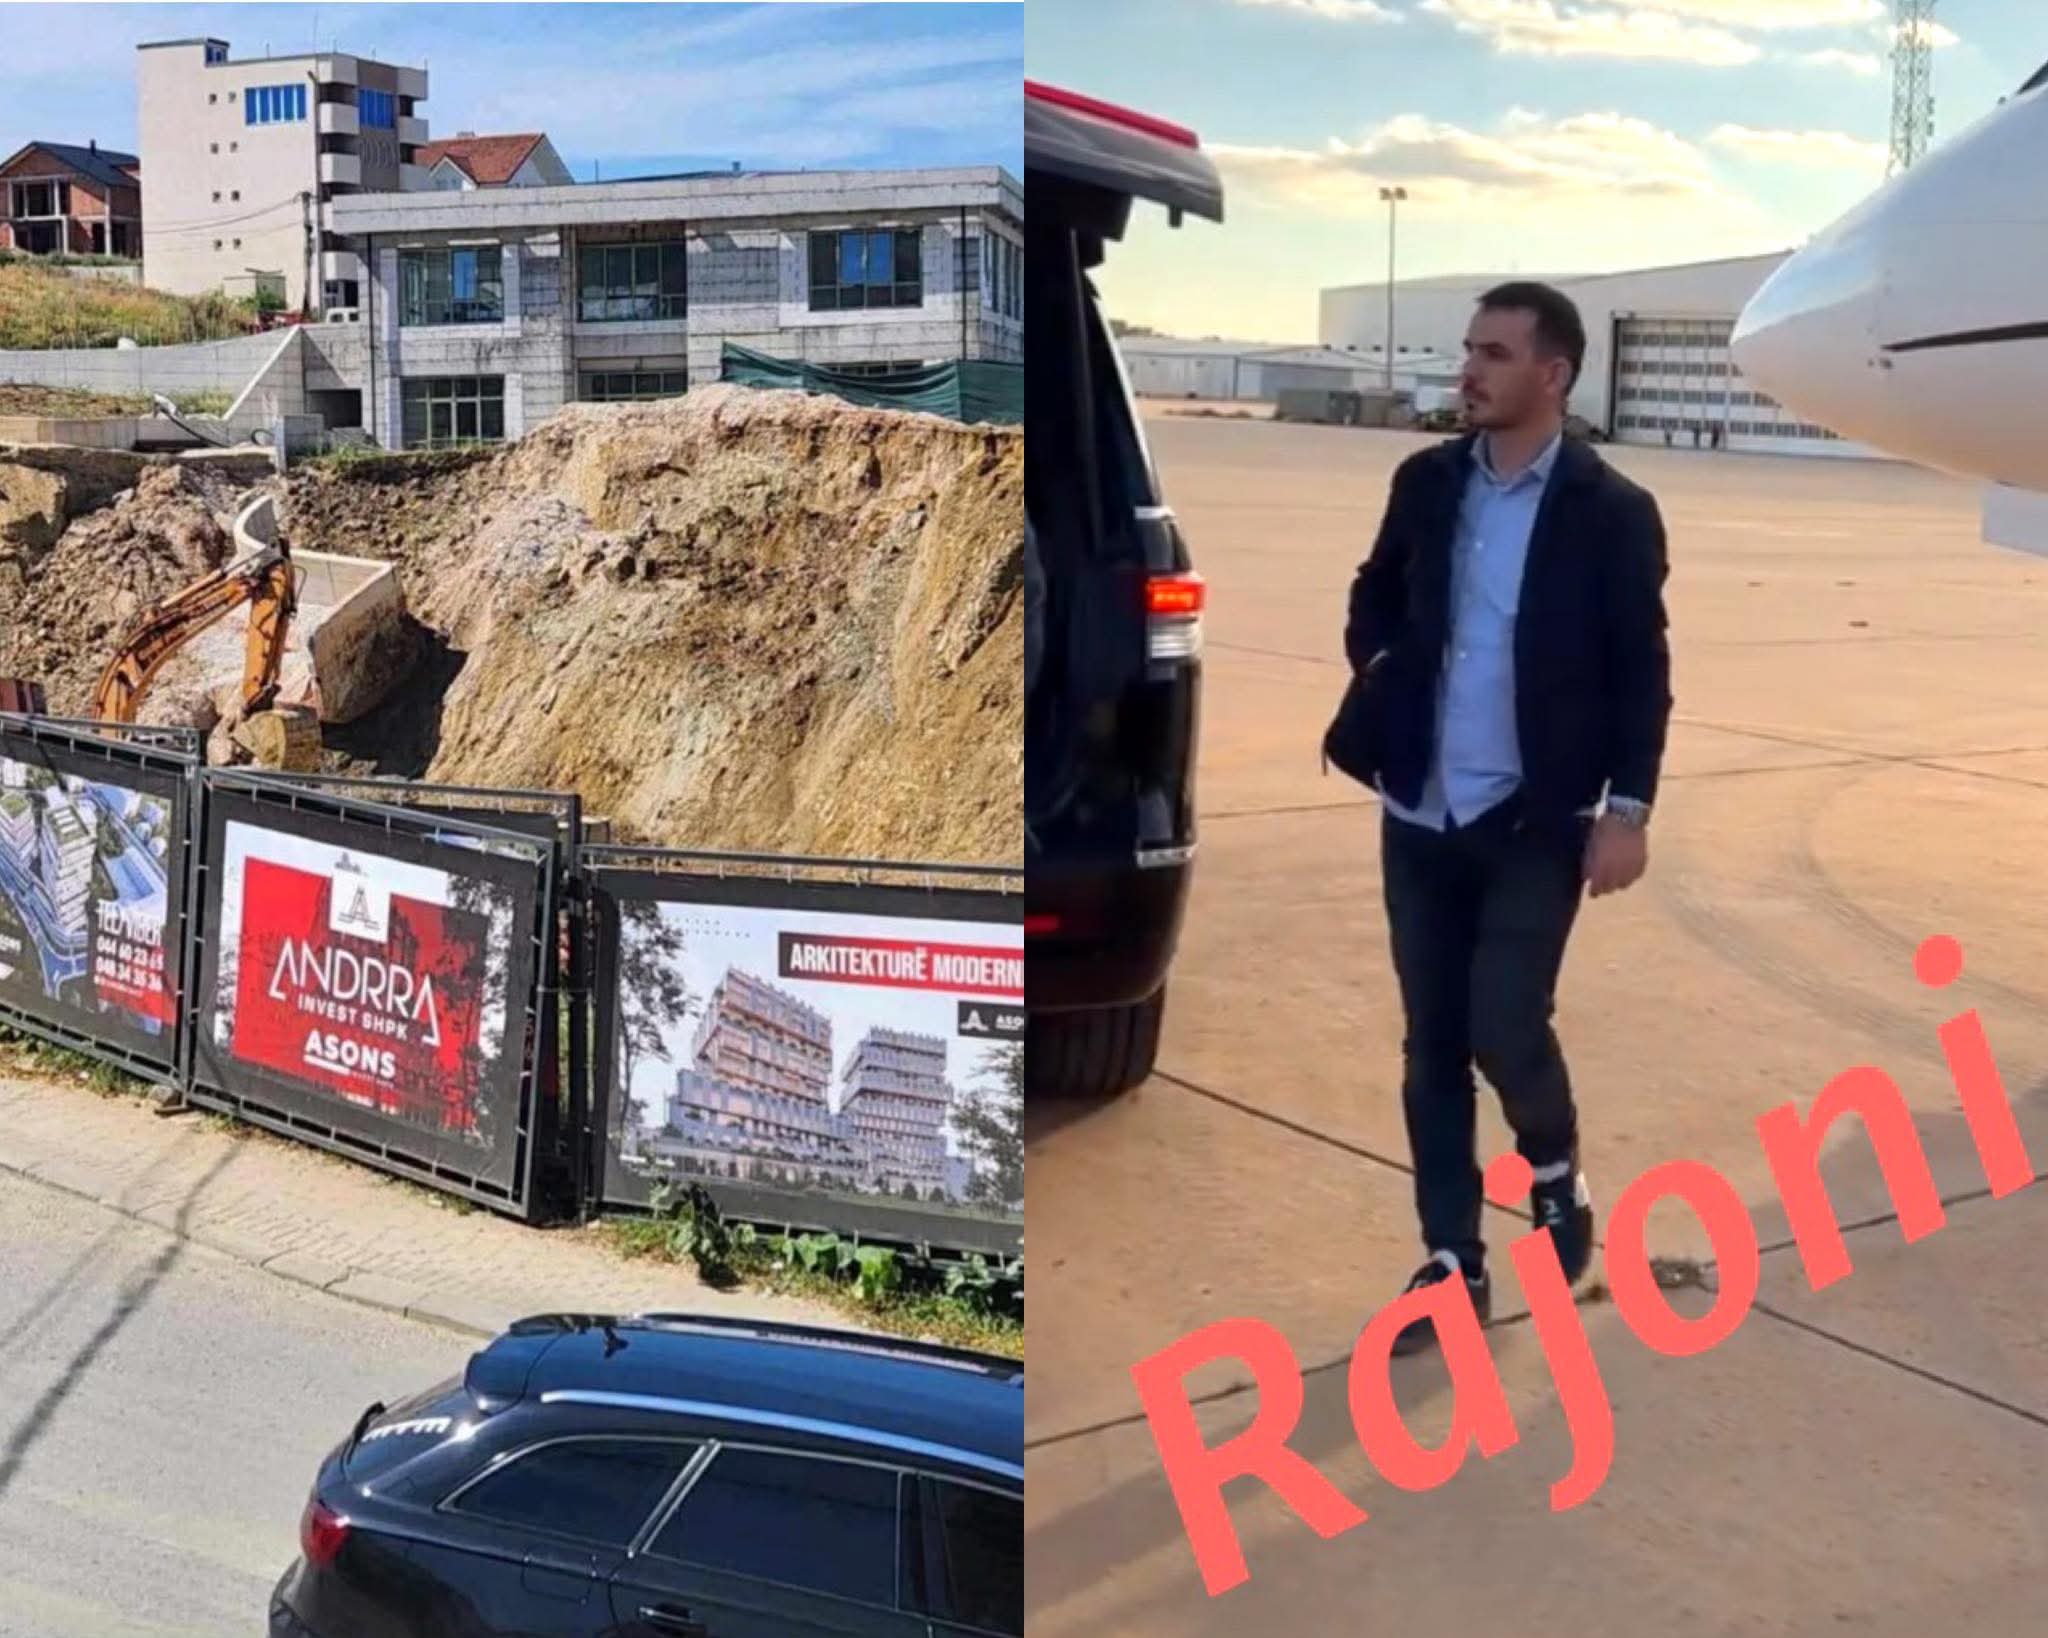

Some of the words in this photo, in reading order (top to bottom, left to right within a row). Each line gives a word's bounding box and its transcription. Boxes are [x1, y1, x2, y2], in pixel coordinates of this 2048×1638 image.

[790, 942, 928, 981] ARKITEKTURË
[932, 953, 1024, 988] MODERN
[269, 937, 441, 1047] ANDRRA
[298, 992, 358, 1026] INVEST
[361, 1011, 408, 1042] SHPK
[995, 1014, 1024, 1027] ASO
[305, 1028, 396, 1079] ASONS
